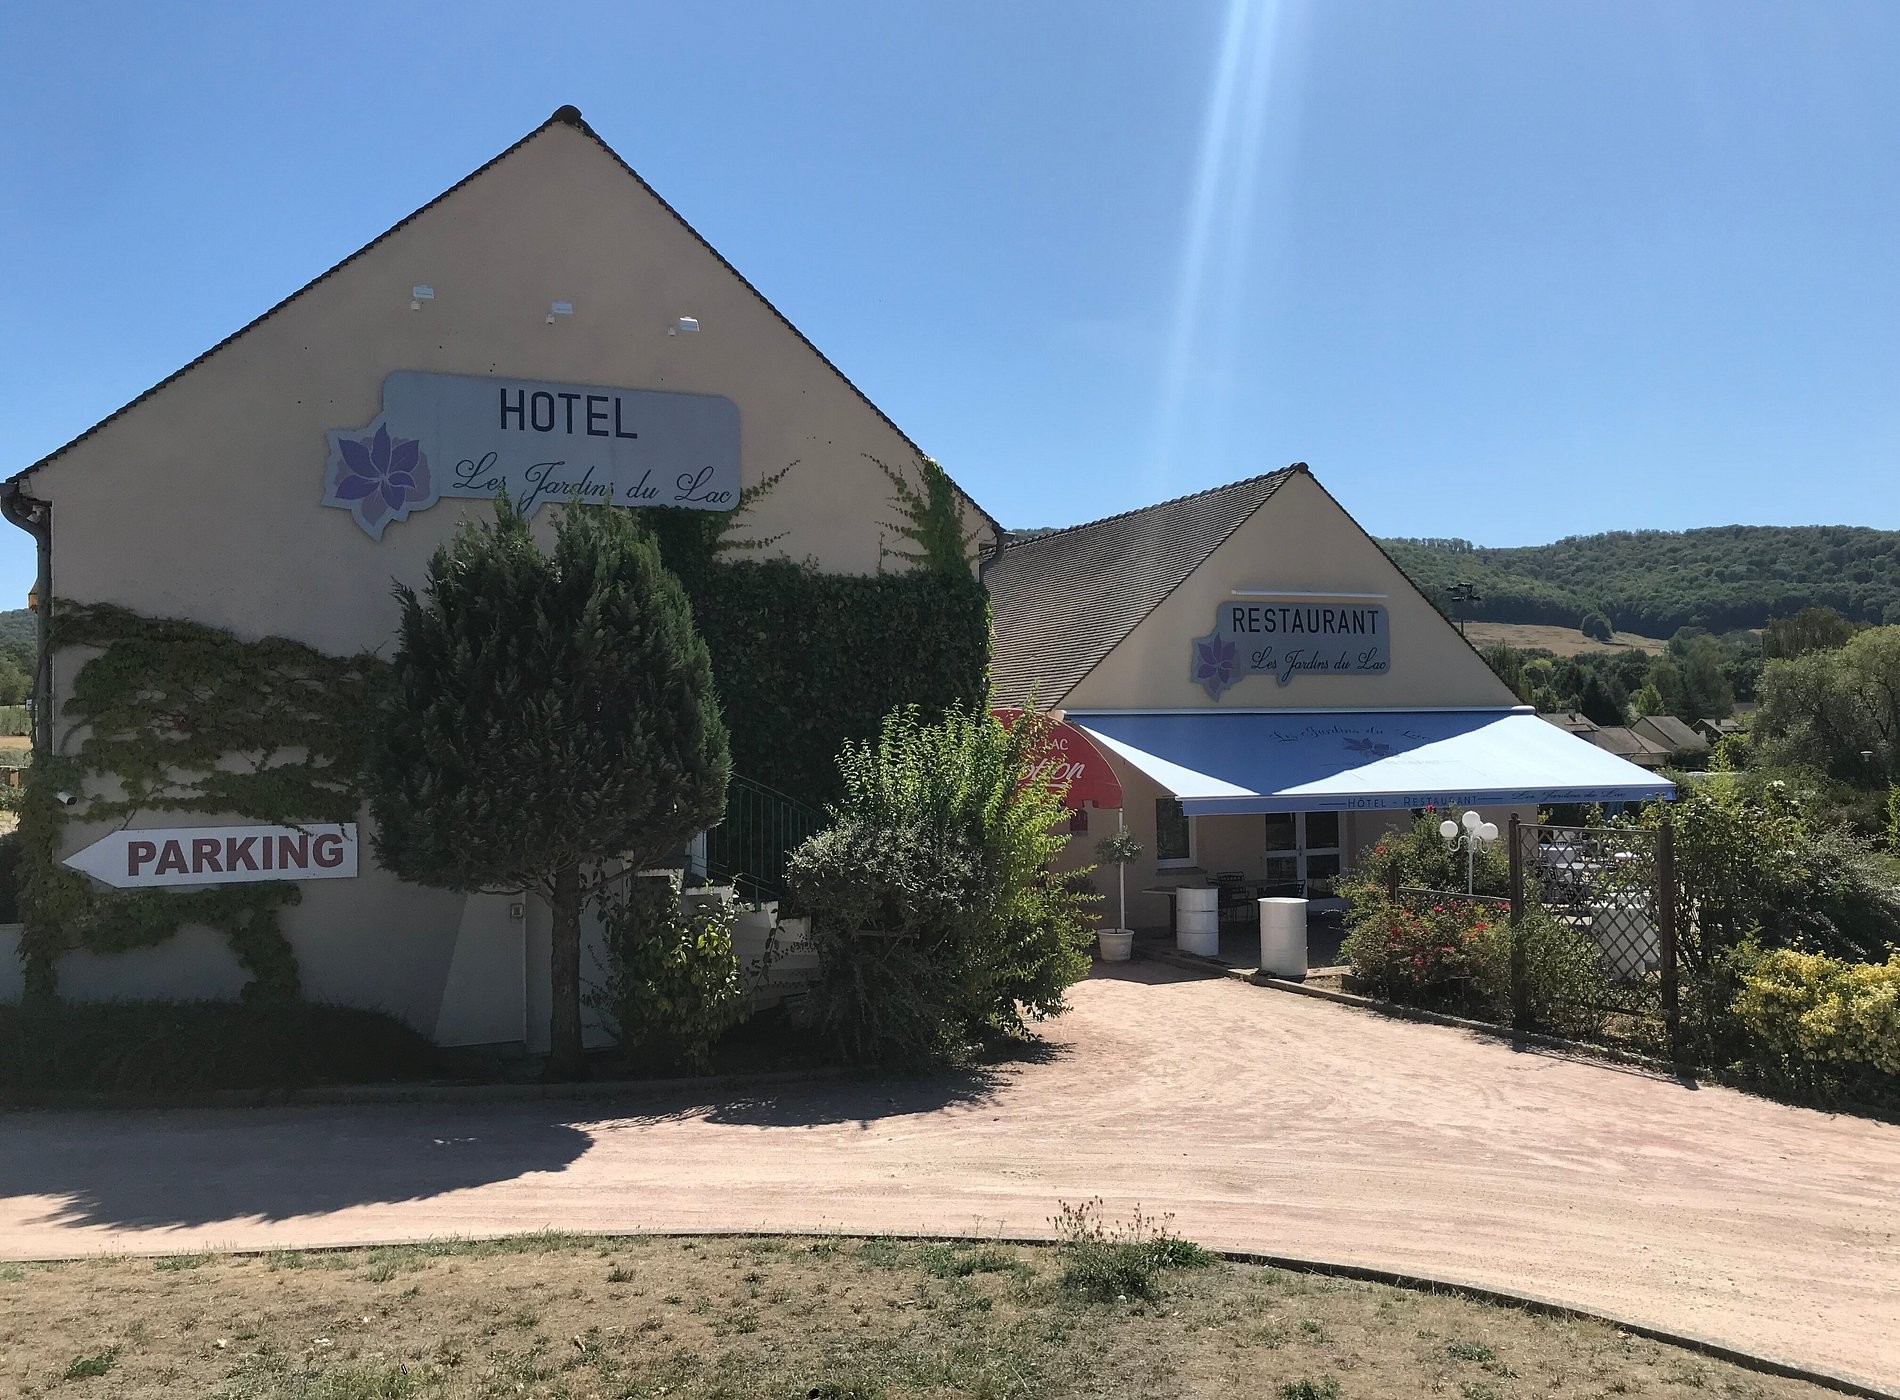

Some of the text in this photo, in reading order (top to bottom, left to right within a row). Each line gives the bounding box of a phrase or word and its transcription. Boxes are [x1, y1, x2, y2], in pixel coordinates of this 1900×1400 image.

[500, 387, 638, 439] HOTEL
[452, 451, 507, 491] Les
[626, 469, 661, 499] du
[676, 466, 733, 506] Lac
[1232, 607, 1379, 635] RESTAURANT
[1251, 646, 1387, 682] Les Jardins du Lac
[127, 833, 344, 876] PARKING
